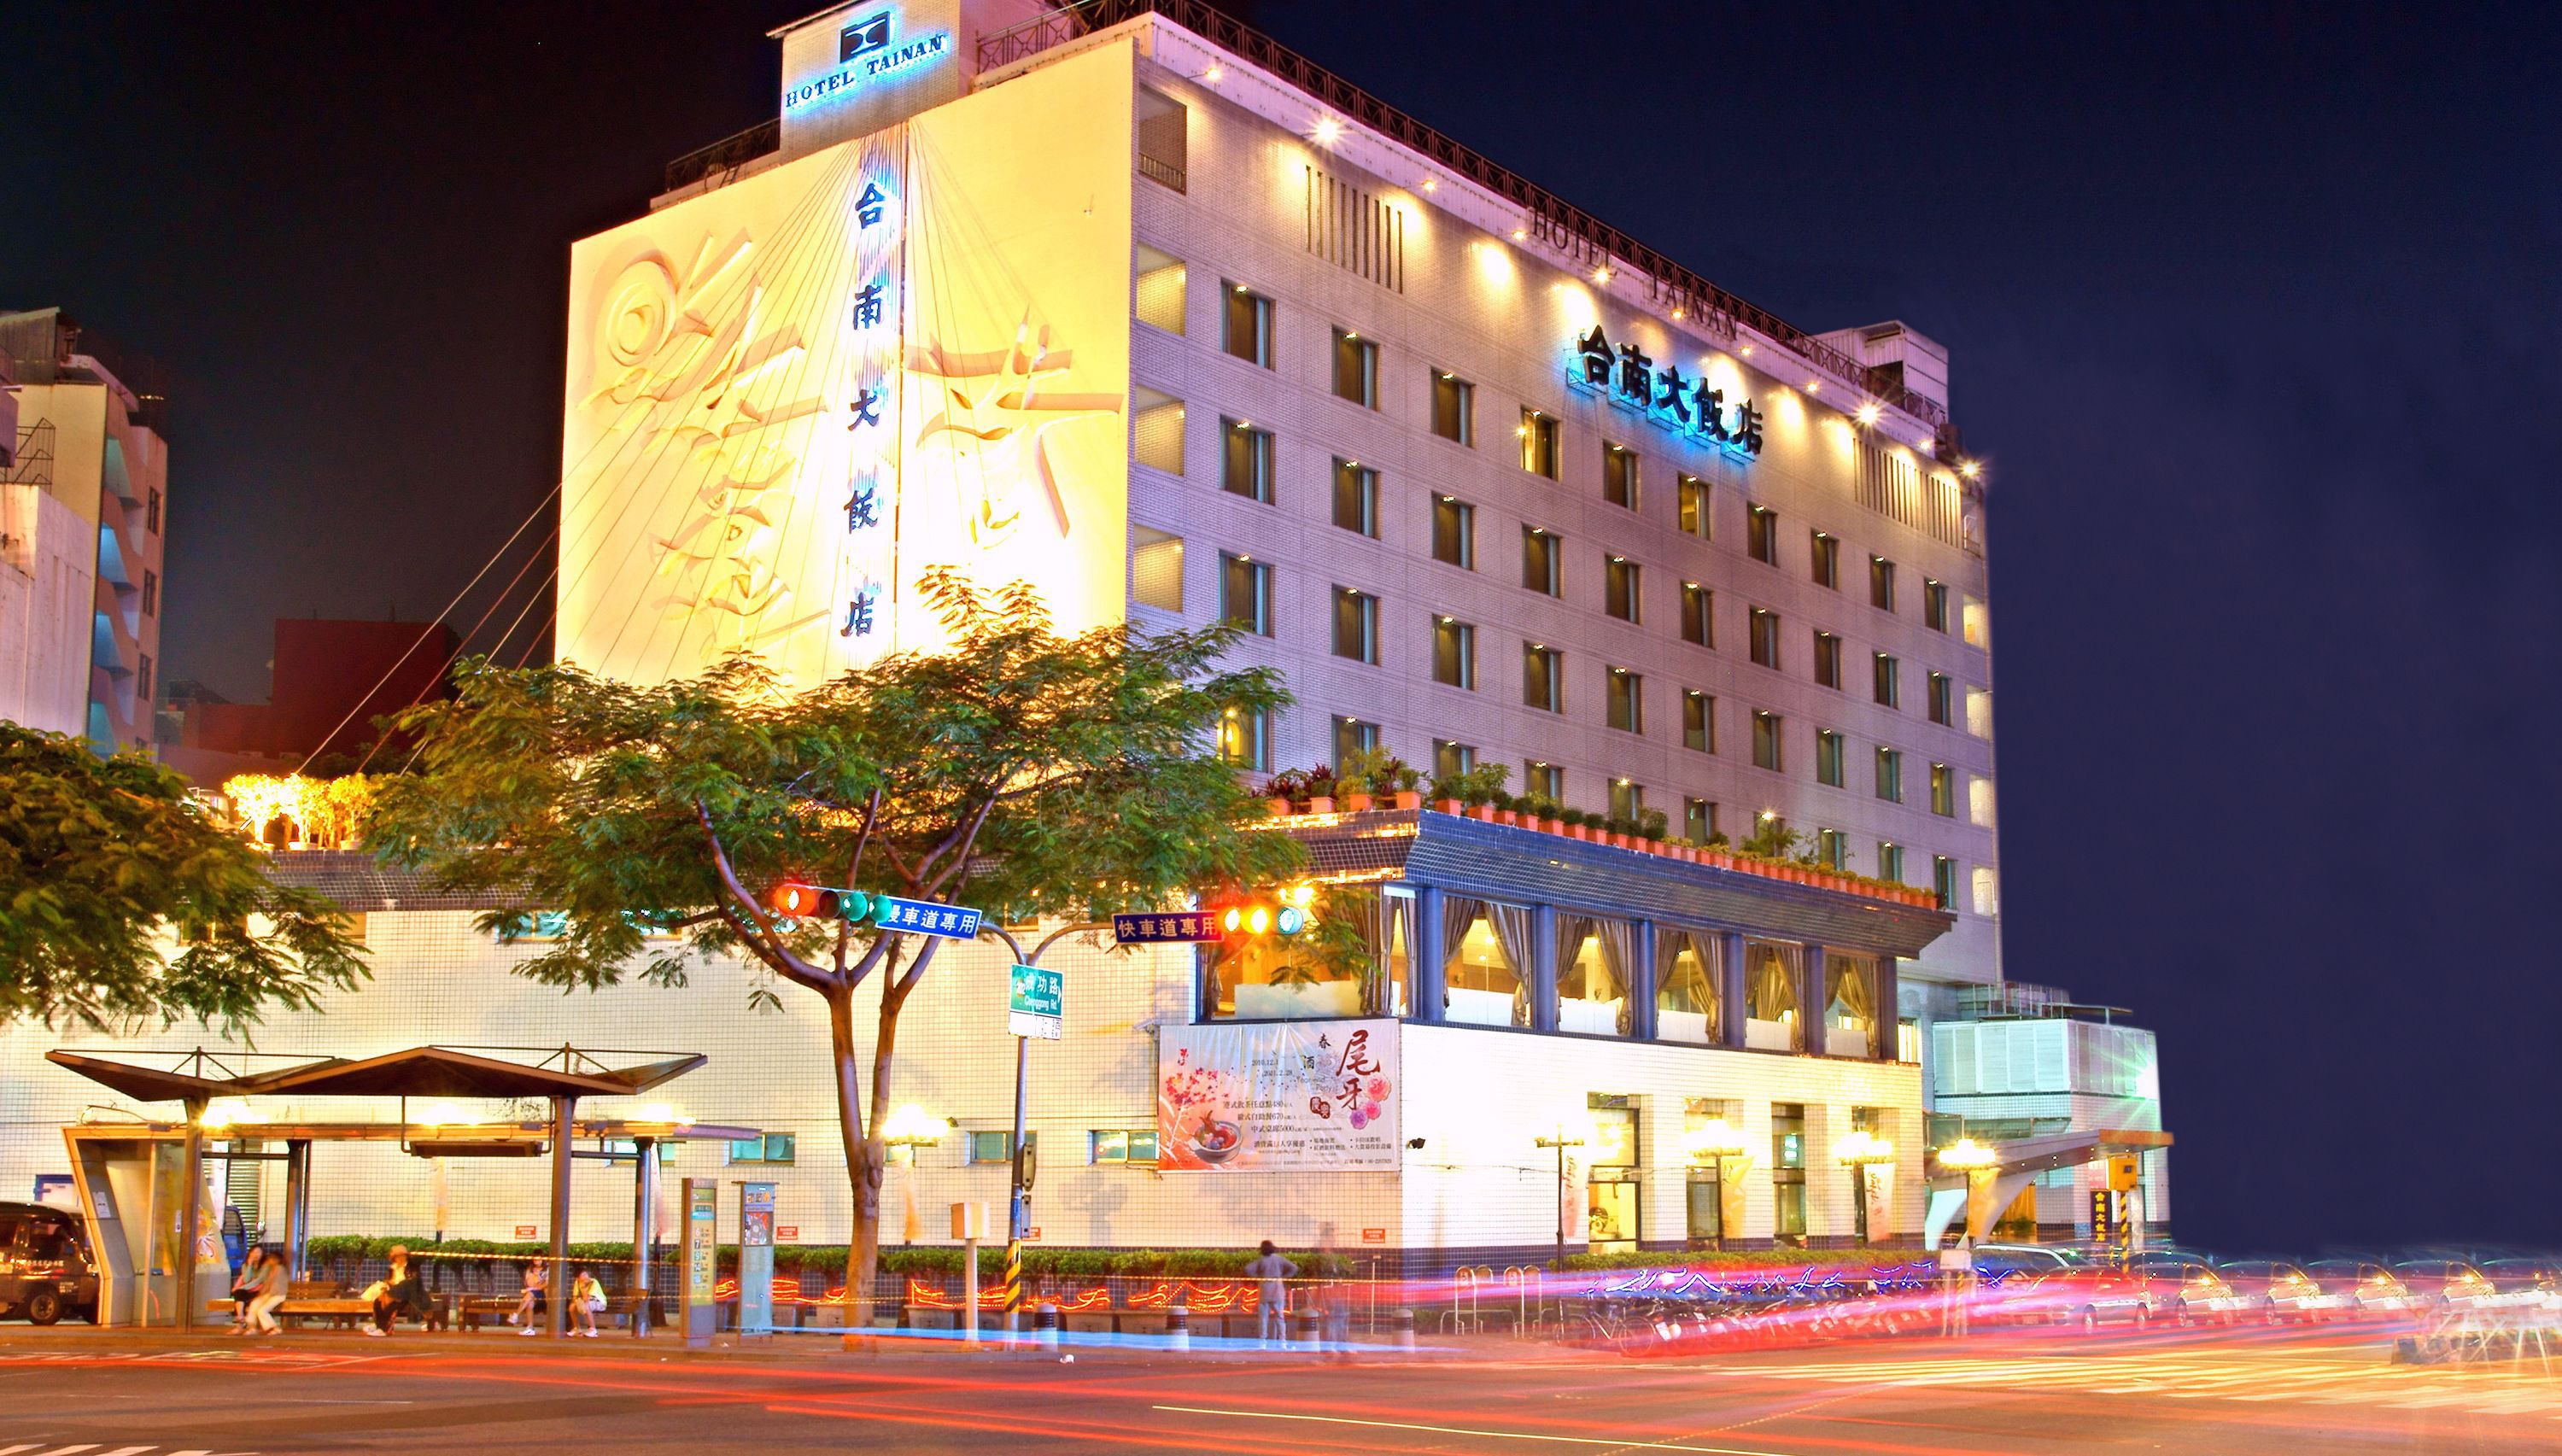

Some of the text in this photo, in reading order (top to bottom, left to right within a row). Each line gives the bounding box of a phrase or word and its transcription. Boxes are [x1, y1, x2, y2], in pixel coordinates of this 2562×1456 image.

[786, 34, 945, 108] HOTEL TAINAN
[840, 182, 886, 638] 台南大飯店
[1576, 325, 1764, 455] 台南大飯店
[1118, 916, 1220, 939] 快車道專用
[1025, 972, 1058, 995] 成功路
[1335, 1029, 1381, 1111] 尾牙
